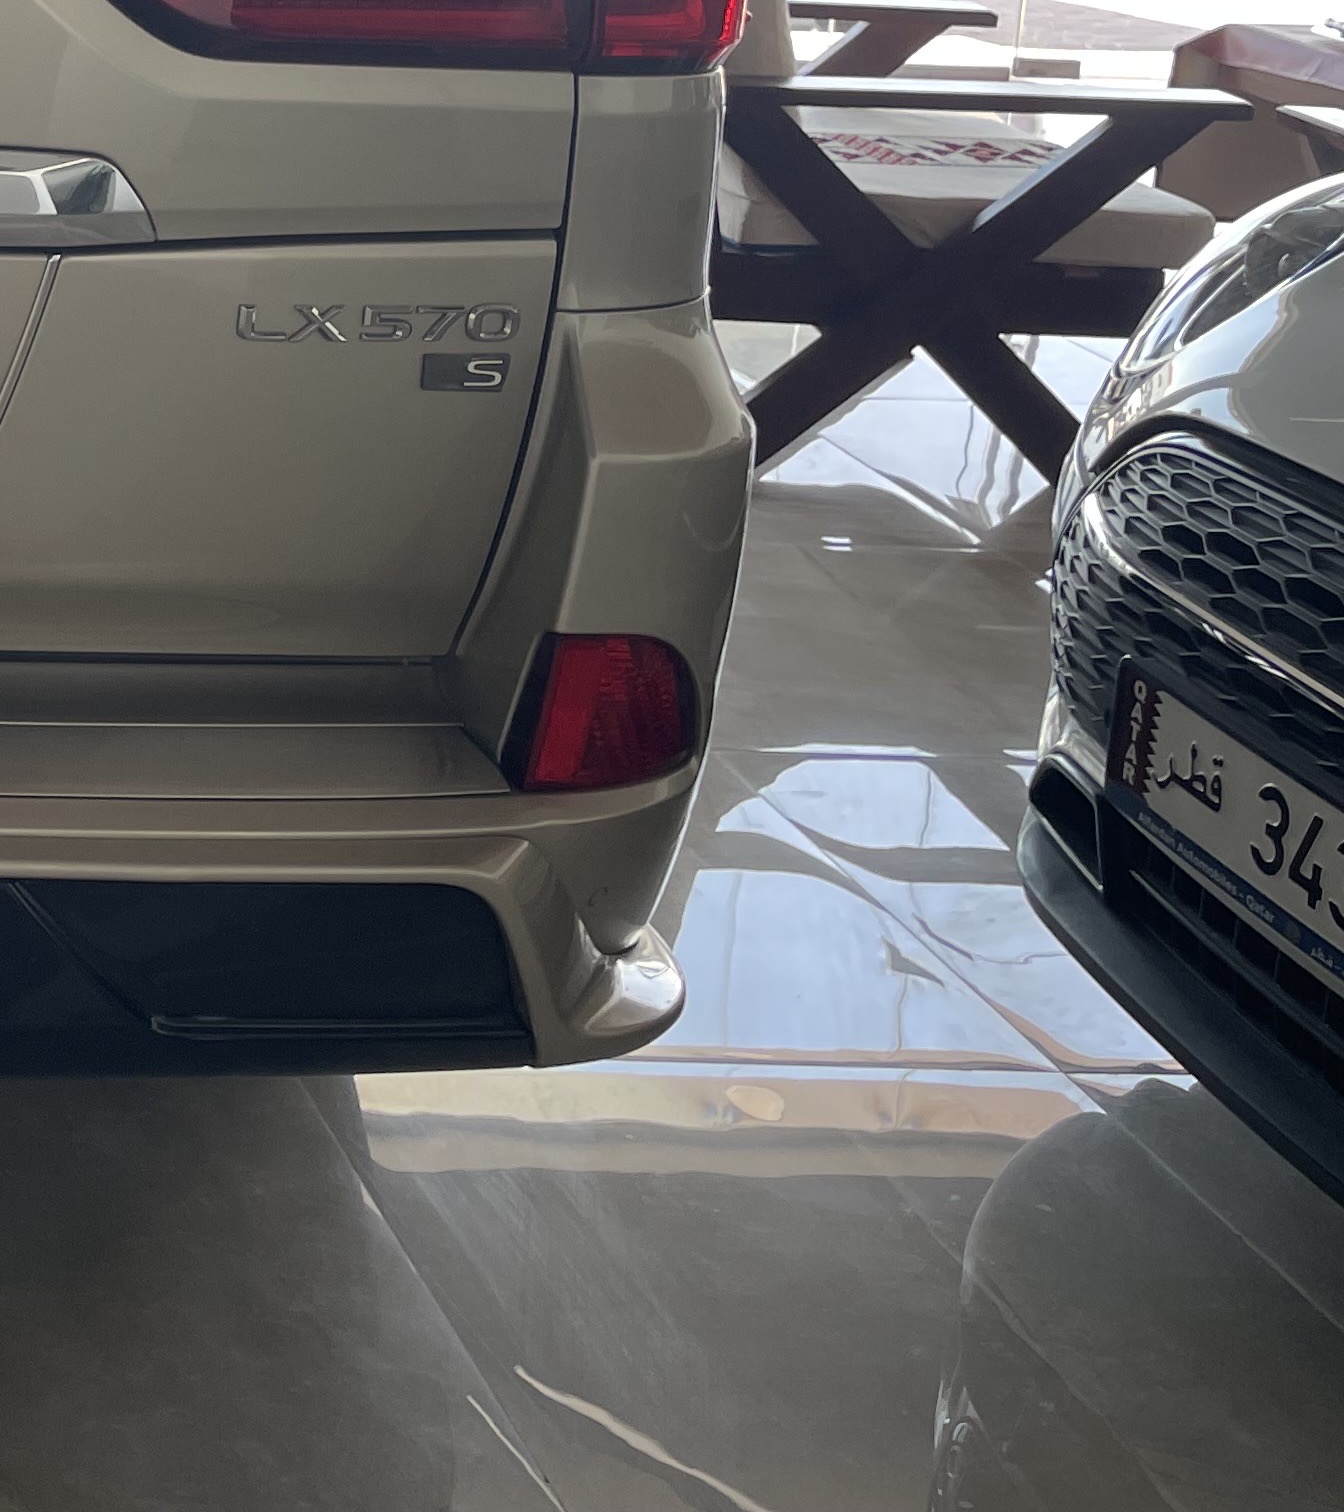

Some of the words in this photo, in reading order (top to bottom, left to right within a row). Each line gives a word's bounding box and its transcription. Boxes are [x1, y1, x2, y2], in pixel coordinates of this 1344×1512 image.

[235, 303, 348, 343] LX
[358, 303, 521, 343] 570
[463, 358, 505, 388] S
[1122, 679, 1148, 786] QATAR
[1150, 740, 1225, 813] قطر
